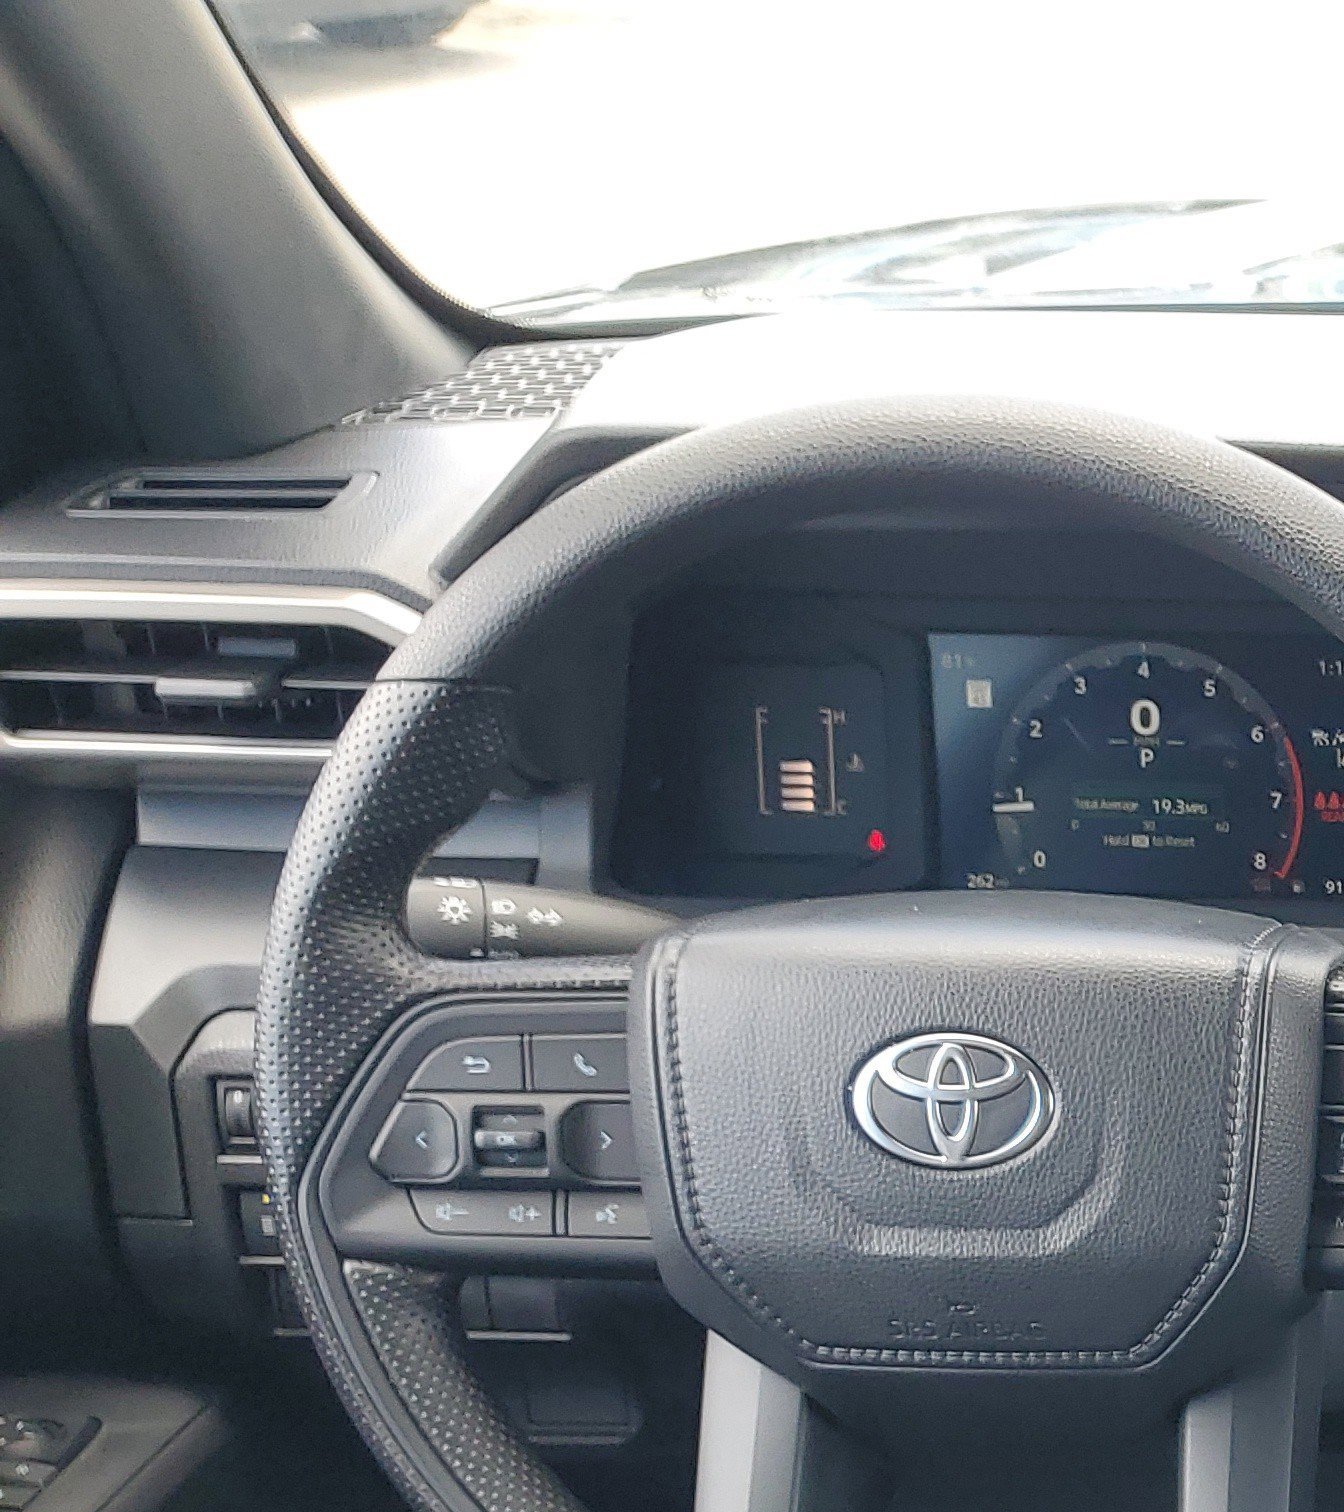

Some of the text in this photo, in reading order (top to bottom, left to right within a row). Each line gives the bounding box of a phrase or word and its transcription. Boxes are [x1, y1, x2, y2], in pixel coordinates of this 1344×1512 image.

[1138, 662, 1150, 679] 4
[1074, 679, 1087, 695] 3
[1203, 679, 1216, 697] 5
[1130, 699, 1161, 736] 0
[1029, 719, 1042, 738] 2
[1251, 725, 1264, 743] 6
[1139, 748, 1155, 768] P
[1269, 790, 1282, 809] 7
[1033, 850, 1046, 869] 0
[1253, 852, 1267, 870] 8
